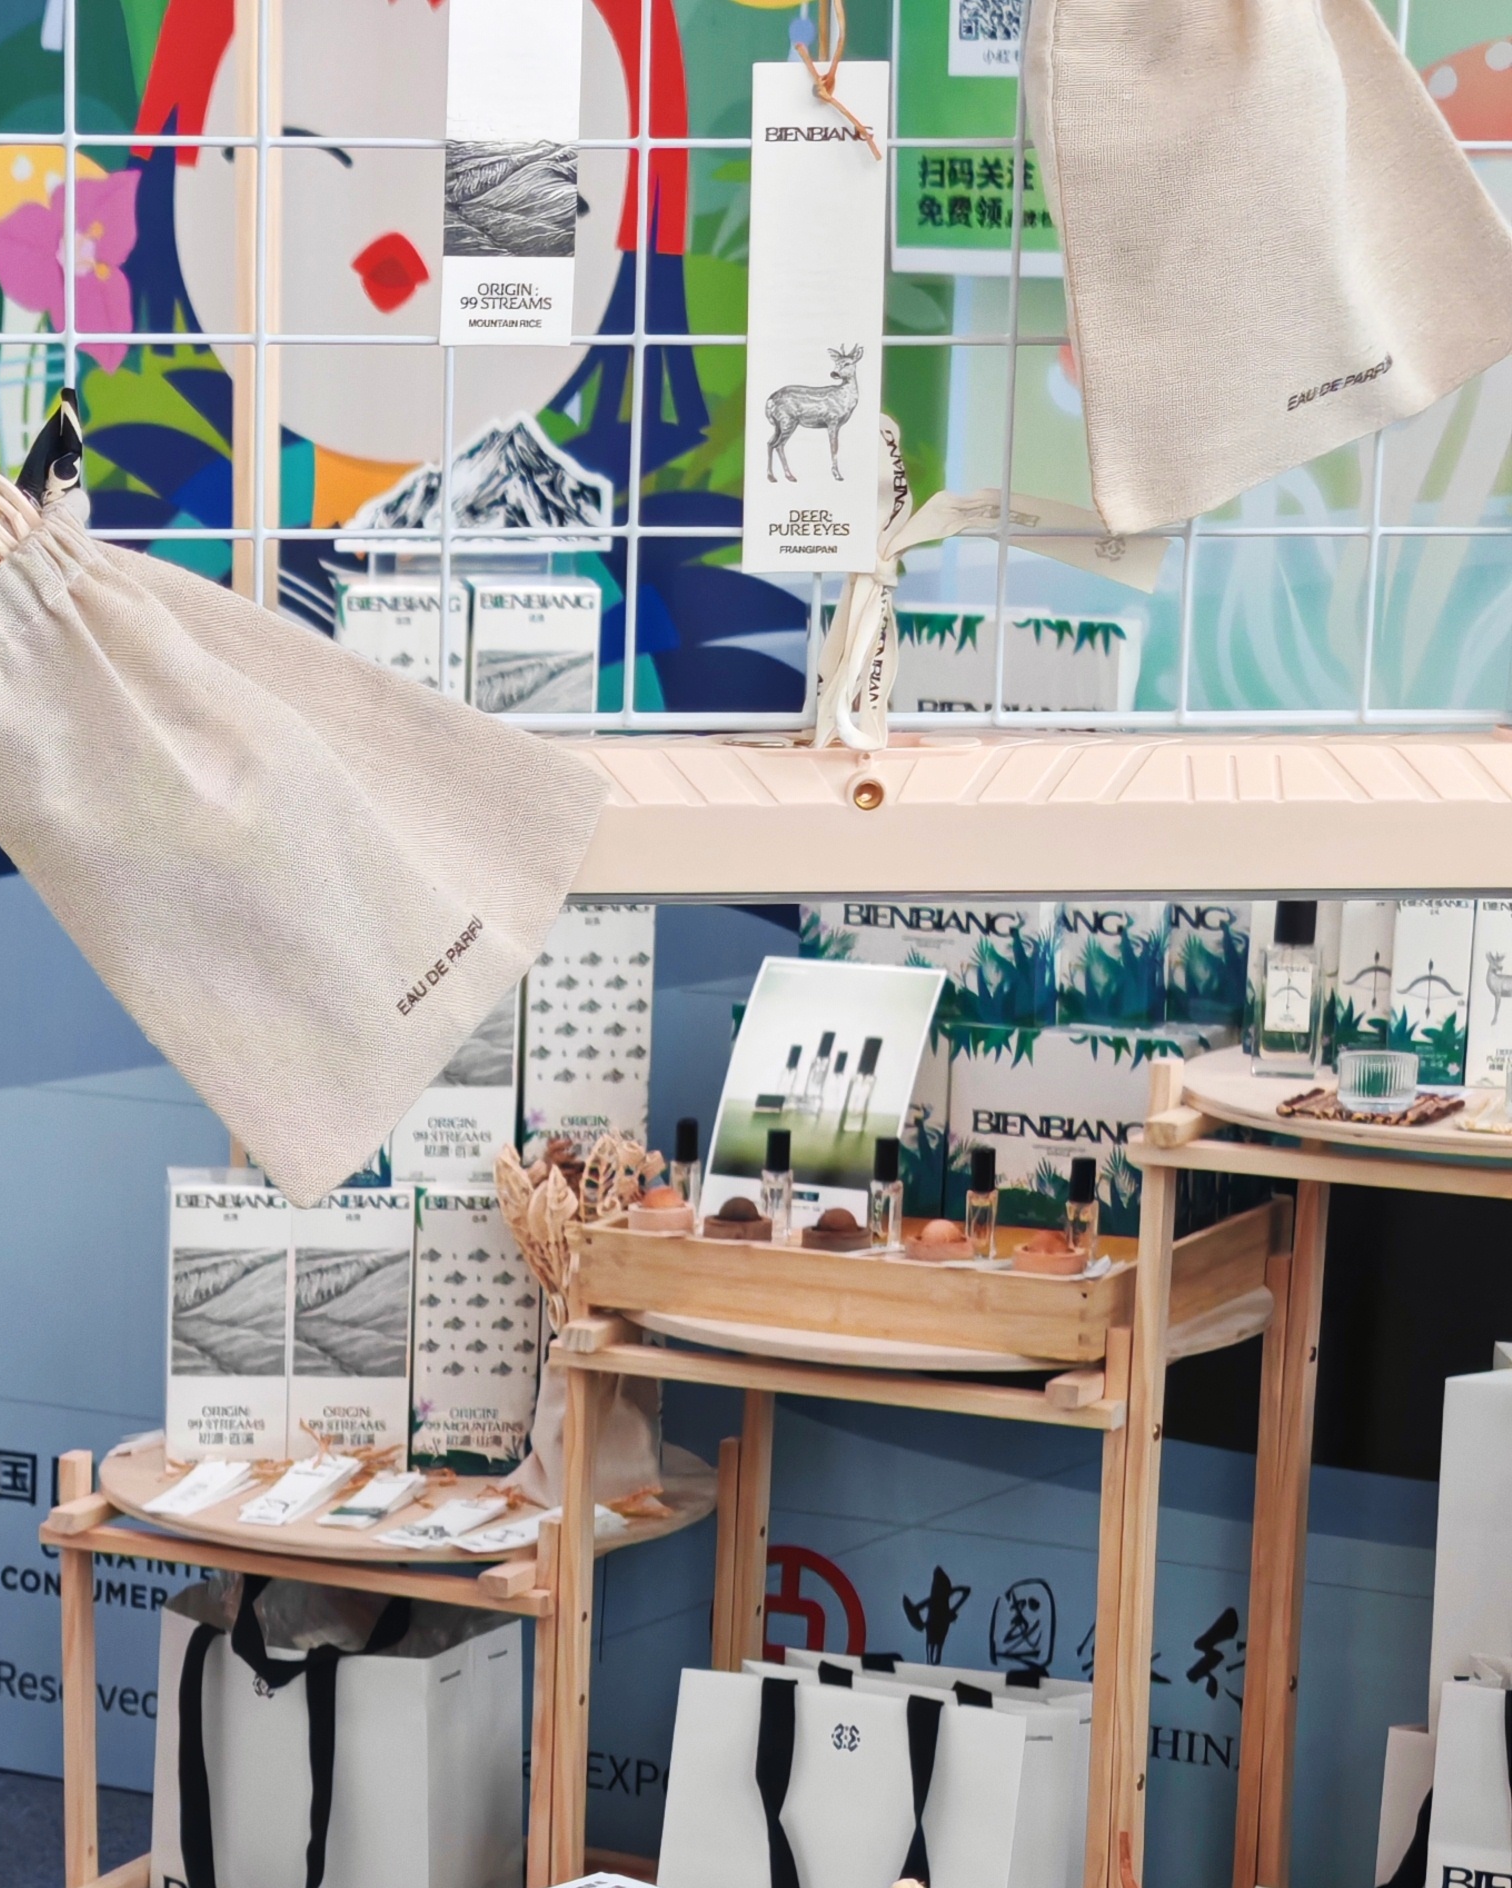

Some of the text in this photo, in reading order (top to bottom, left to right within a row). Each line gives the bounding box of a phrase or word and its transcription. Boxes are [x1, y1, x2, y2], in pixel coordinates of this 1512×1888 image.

[764, 127, 874, 142] BIENBIANG
[460, 297, 552, 310] 99 STREAMS
[468, 319, 542, 328] MOUNTAIN RICE
[1287, 378, 1343, 411] EAU DE
[789, 510, 833, 523] DEER:
[769, 523, 850, 536] PURE EYES
[779, 545, 838, 554] FRANGIPANI
[842, 903, 1017, 937] BIENBIANG
[1171, 905, 1228, 931] NG
[396, 981, 427, 1016] EAU
[425, 958, 450, 987] DE
[175, 1193, 287, 1210] BIENBIANG
[0, 1565, 169, 1612] CONUMER
[1150, 1724, 1240, 1770] HIN
